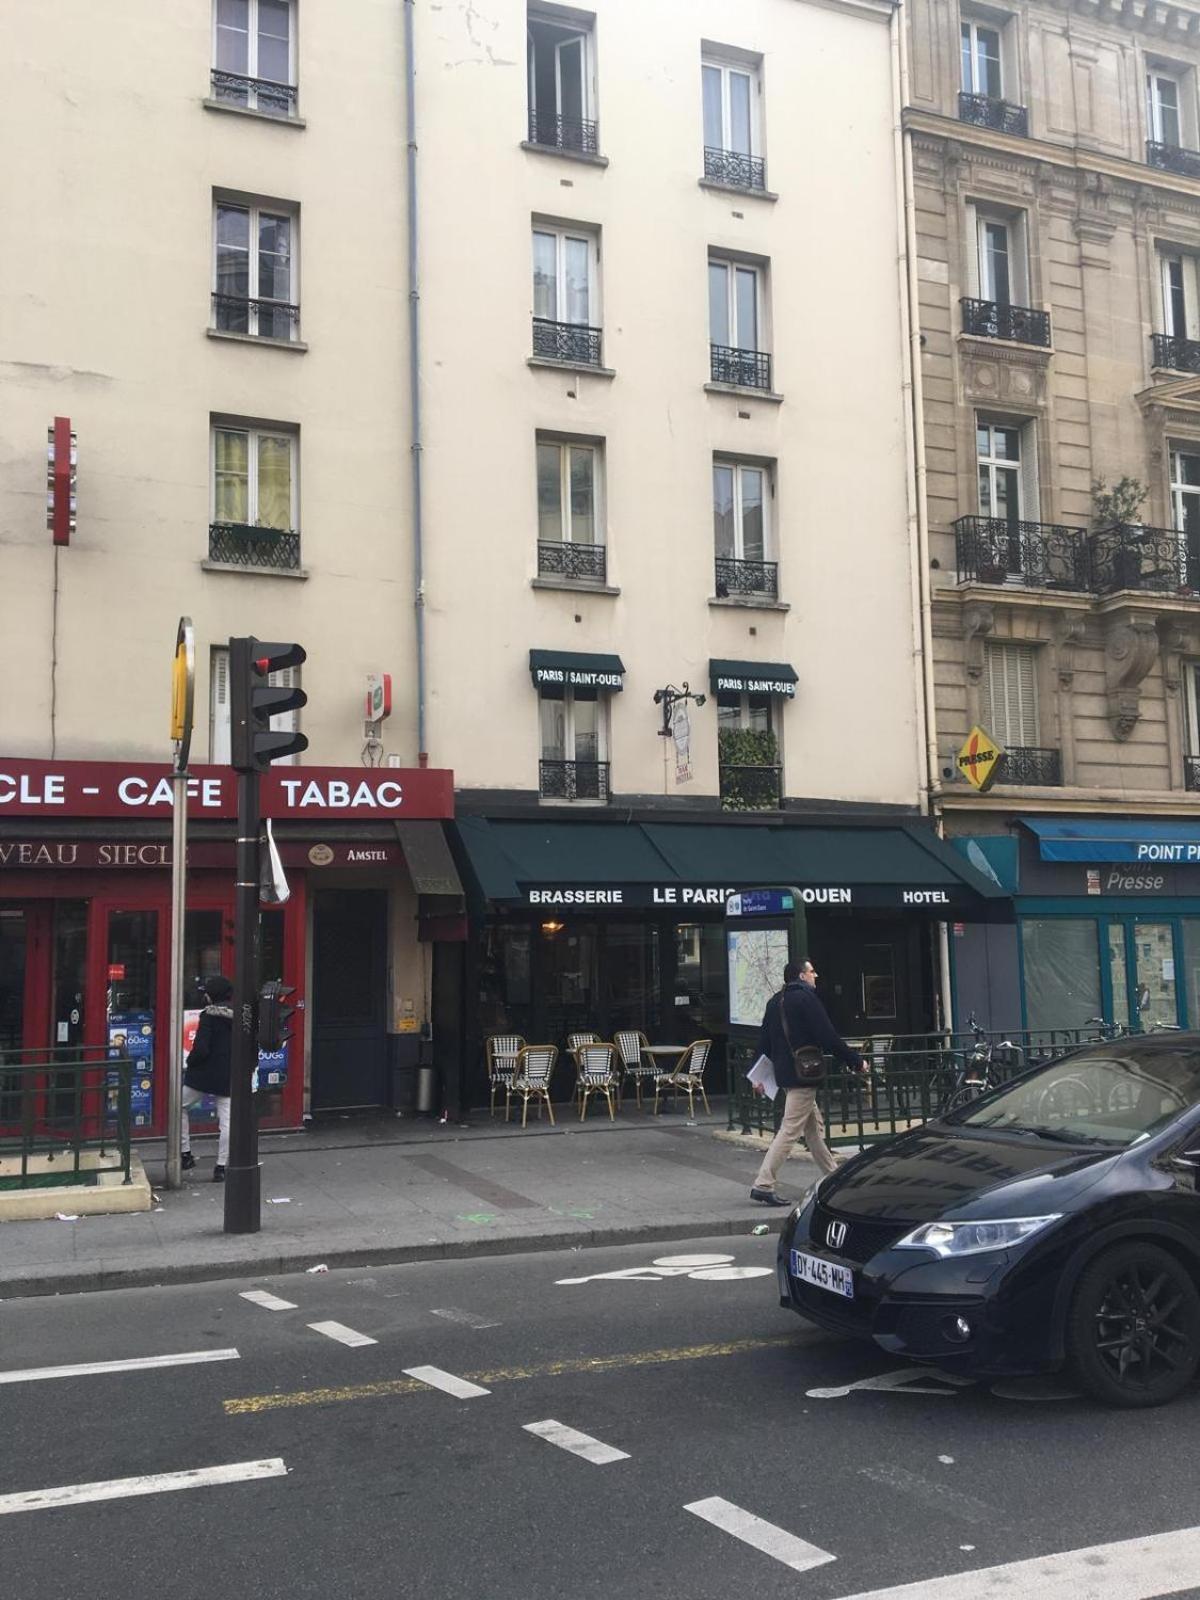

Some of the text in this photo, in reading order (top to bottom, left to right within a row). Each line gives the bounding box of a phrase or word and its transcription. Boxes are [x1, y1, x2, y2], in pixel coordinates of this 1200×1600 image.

[537, 670, 564, 682] PARIS
[718, 678, 743, 690] PARIS
[959, 751, 993, 767] PRESSE
[117, 777, 222, 807] CAFE
[279, 780, 403, 808] TABAC
[98, 845, 189, 865] SIECL
[1137, 845, 1200, 860] POINT P
[1107, 872, 1164, 890] Presse
[529, 890, 623, 904] BRASSERIE
[653, 888, 677, 903] LE
[802, 888, 852, 904] OUEN
[903, 891, 950, 904] HOTEL
